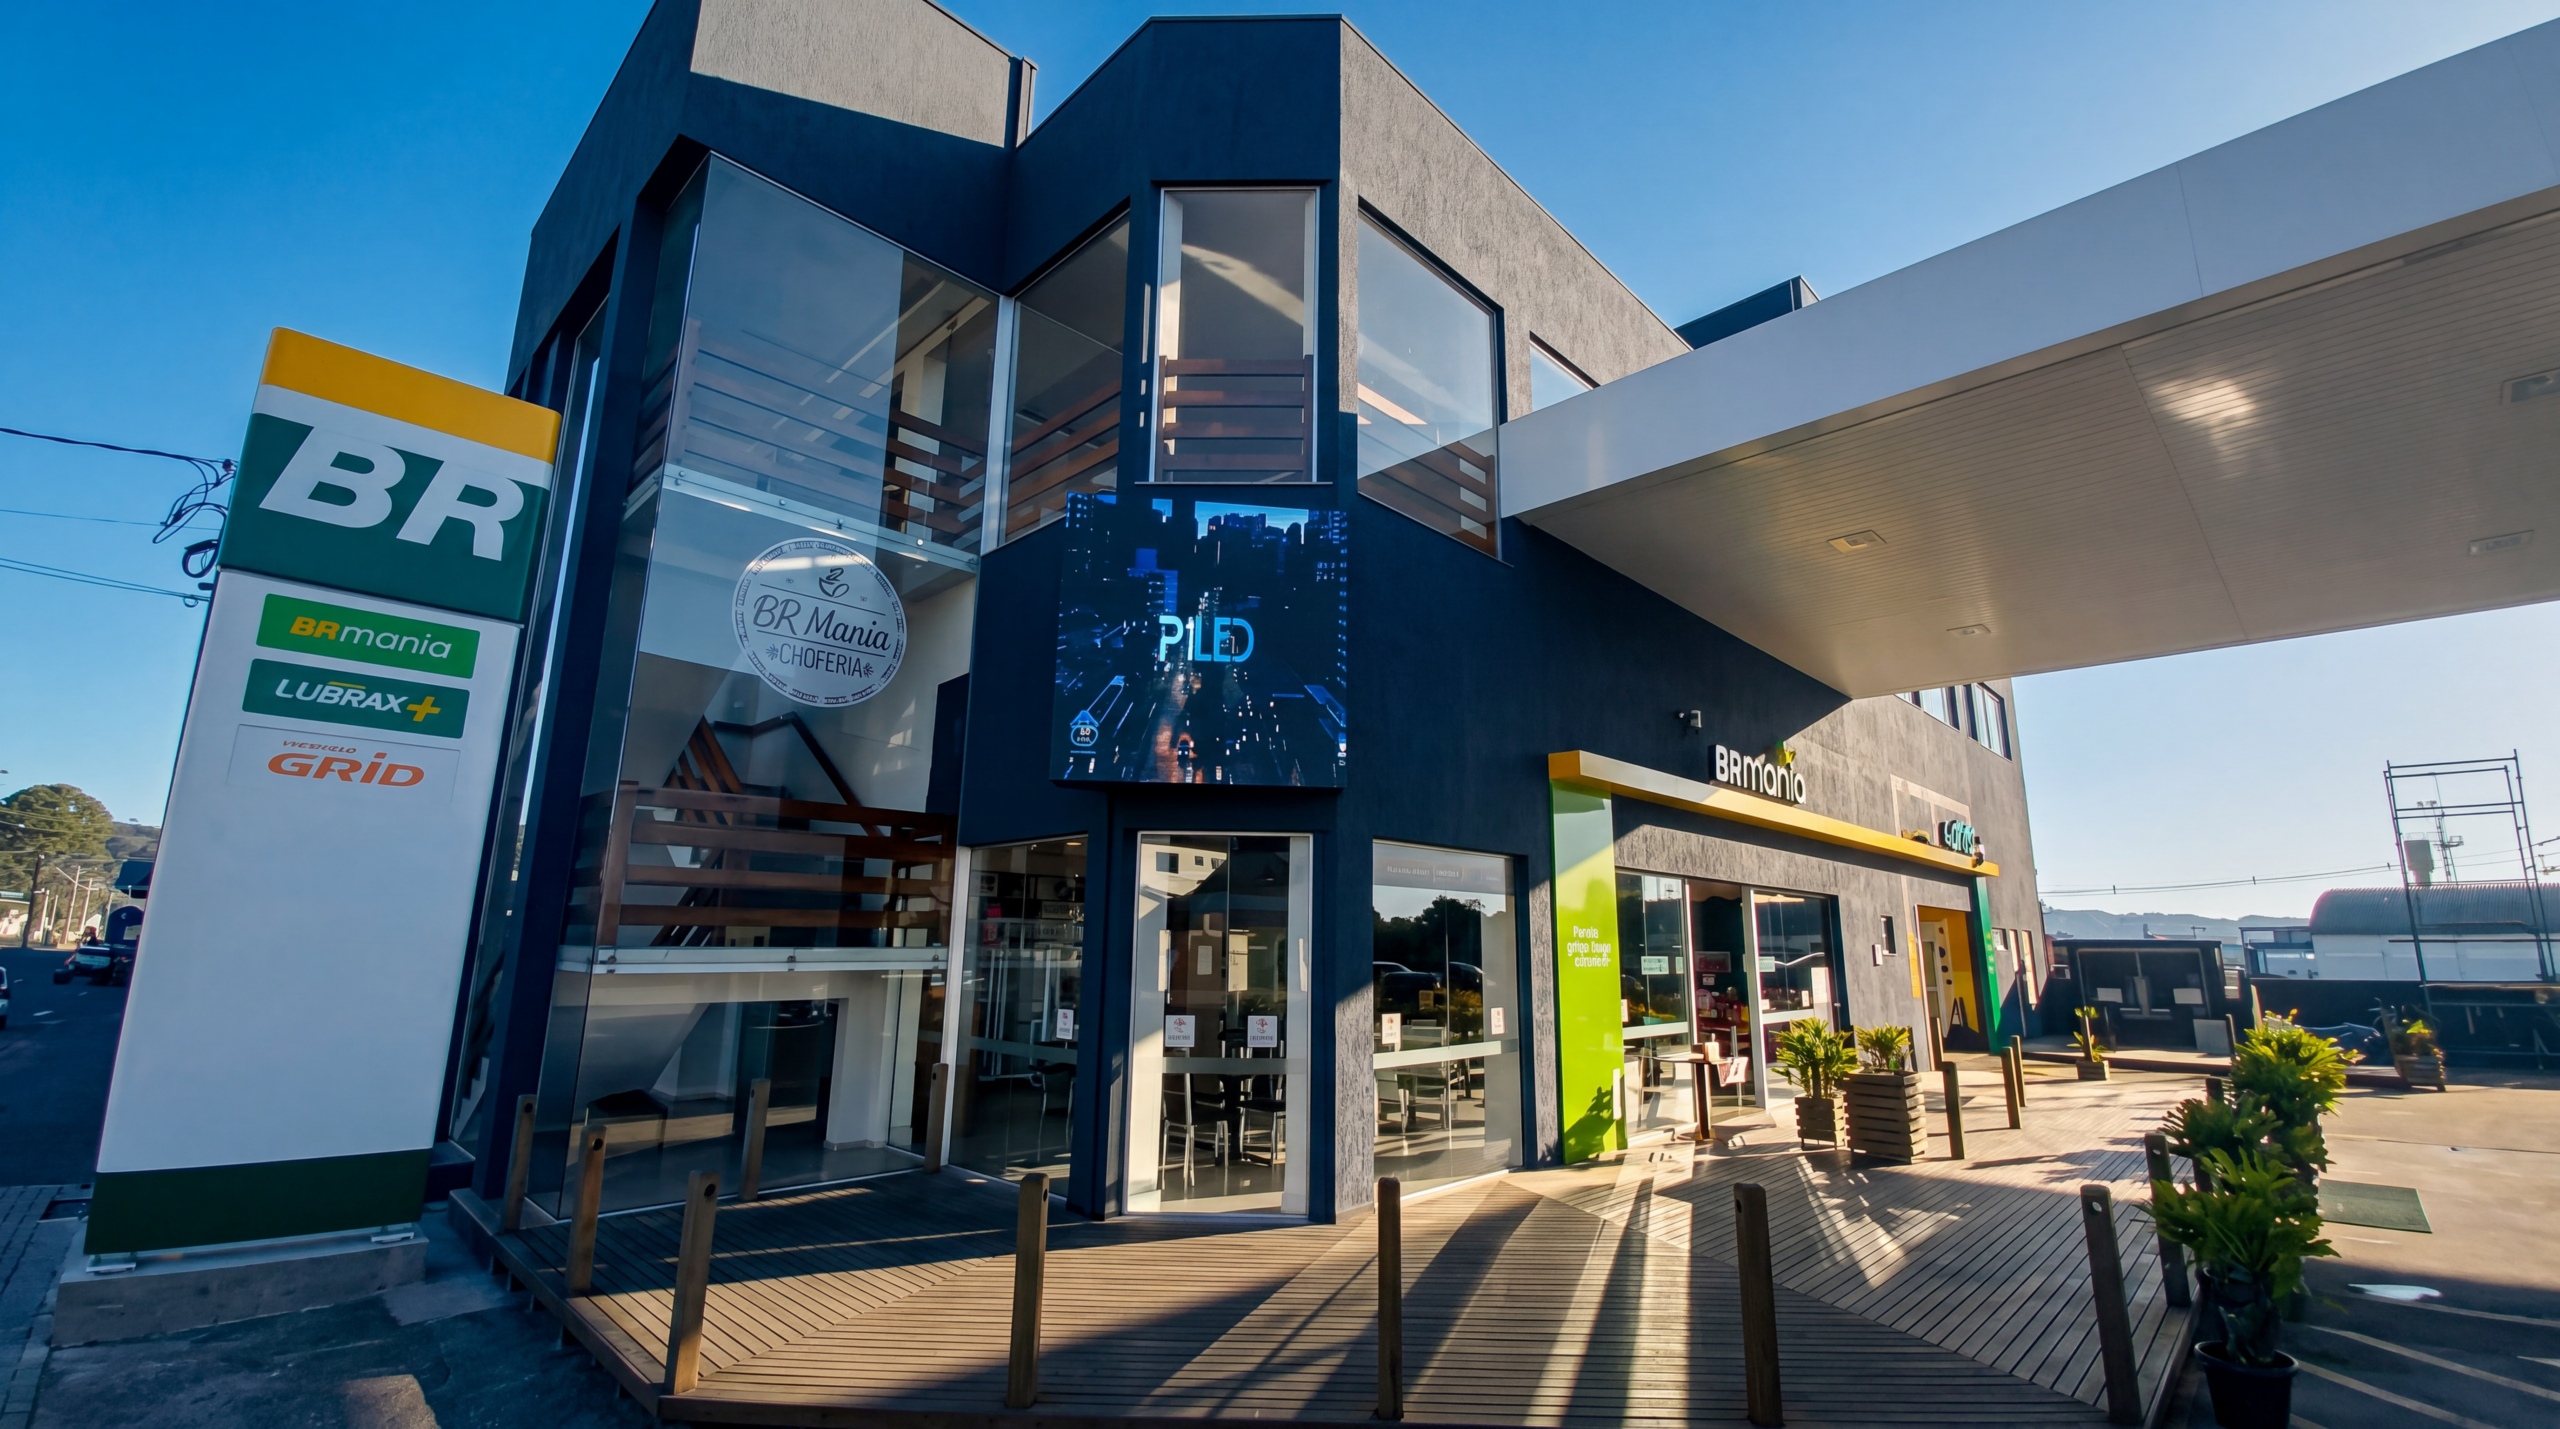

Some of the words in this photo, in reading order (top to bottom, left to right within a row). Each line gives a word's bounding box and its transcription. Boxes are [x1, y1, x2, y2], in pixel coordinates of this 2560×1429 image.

[258, 426, 525, 561] BR
[290, 616, 452, 659] BRmania
[753, 594, 802, 636] BR
[803, 606, 892, 651] Mania
[779, 643, 863, 678] CHOFERIA
